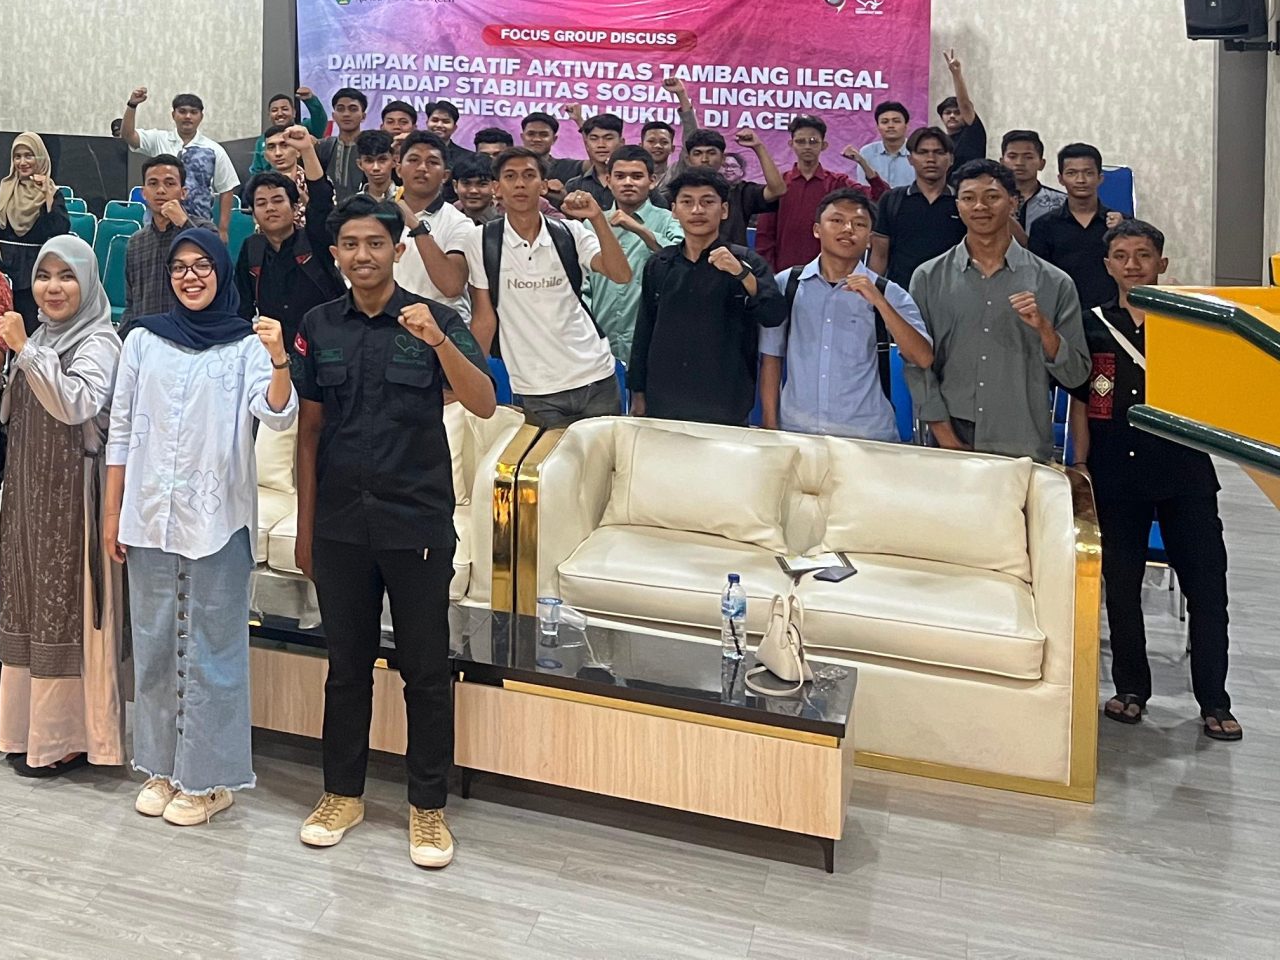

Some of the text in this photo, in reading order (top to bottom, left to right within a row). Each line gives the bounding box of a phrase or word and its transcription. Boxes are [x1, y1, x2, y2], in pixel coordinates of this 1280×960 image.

[500, 28, 677, 45] FOCUS GROUP DISCUSS
[327, 52, 890, 89] DAMPAK NEGATIF AKTIVITAS TAMBANG ILEGAL
[339, 73, 450, 93] TERHADAP
[455, 76, 589, 100] STABILITAS
[699, 87, 872, 112] LINGKUNGAN
[435, 96, 599, 121] ENEGAKKN
[703, 109, 729, 128] DI
[506, 276, 564, 291] Neophile
